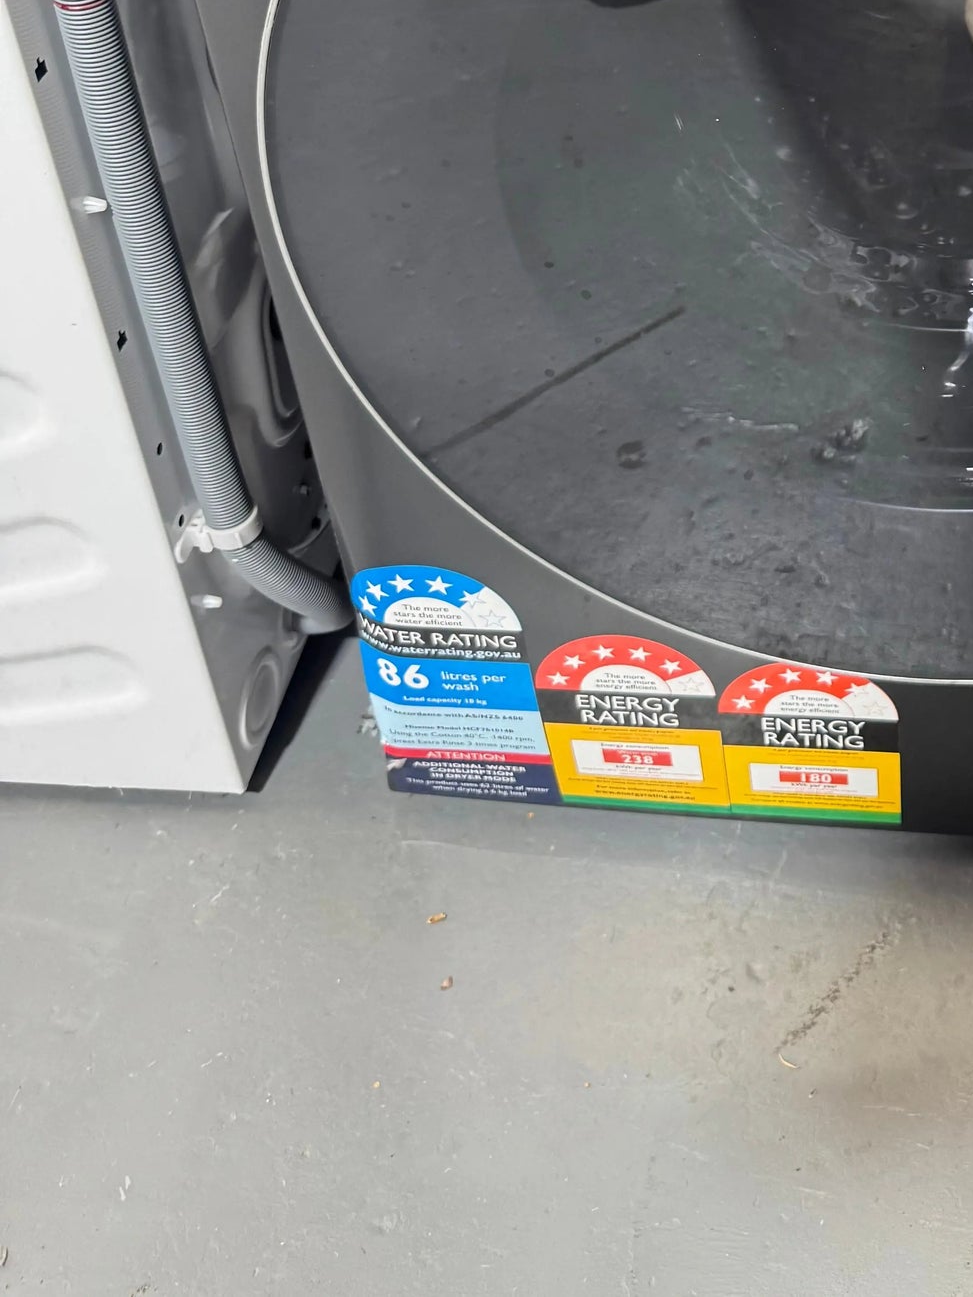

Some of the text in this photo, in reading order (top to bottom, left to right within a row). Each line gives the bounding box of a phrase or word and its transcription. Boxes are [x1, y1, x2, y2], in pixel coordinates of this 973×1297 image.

[403, 603, 420, 611] The
[359, 614, 517, 648] WATER RATING
[377, 658, 429, 689] 86
[441, 671, 506, 684] litres per
[442, 682, 479, 691] wash
[576, 694, 679, 713] ENERGY
[580, 710, 679, 727] RATING
[761, 717, 865, 735] ENERGY
[763, 732, 864, 749] RATING
[426, 751, 506, 761] ATTENTION
[621, 754, 654, 764] 238
[413, 761, 526, 772] ADDITIONAL WATER
[800, 773, 832, 783] 180
